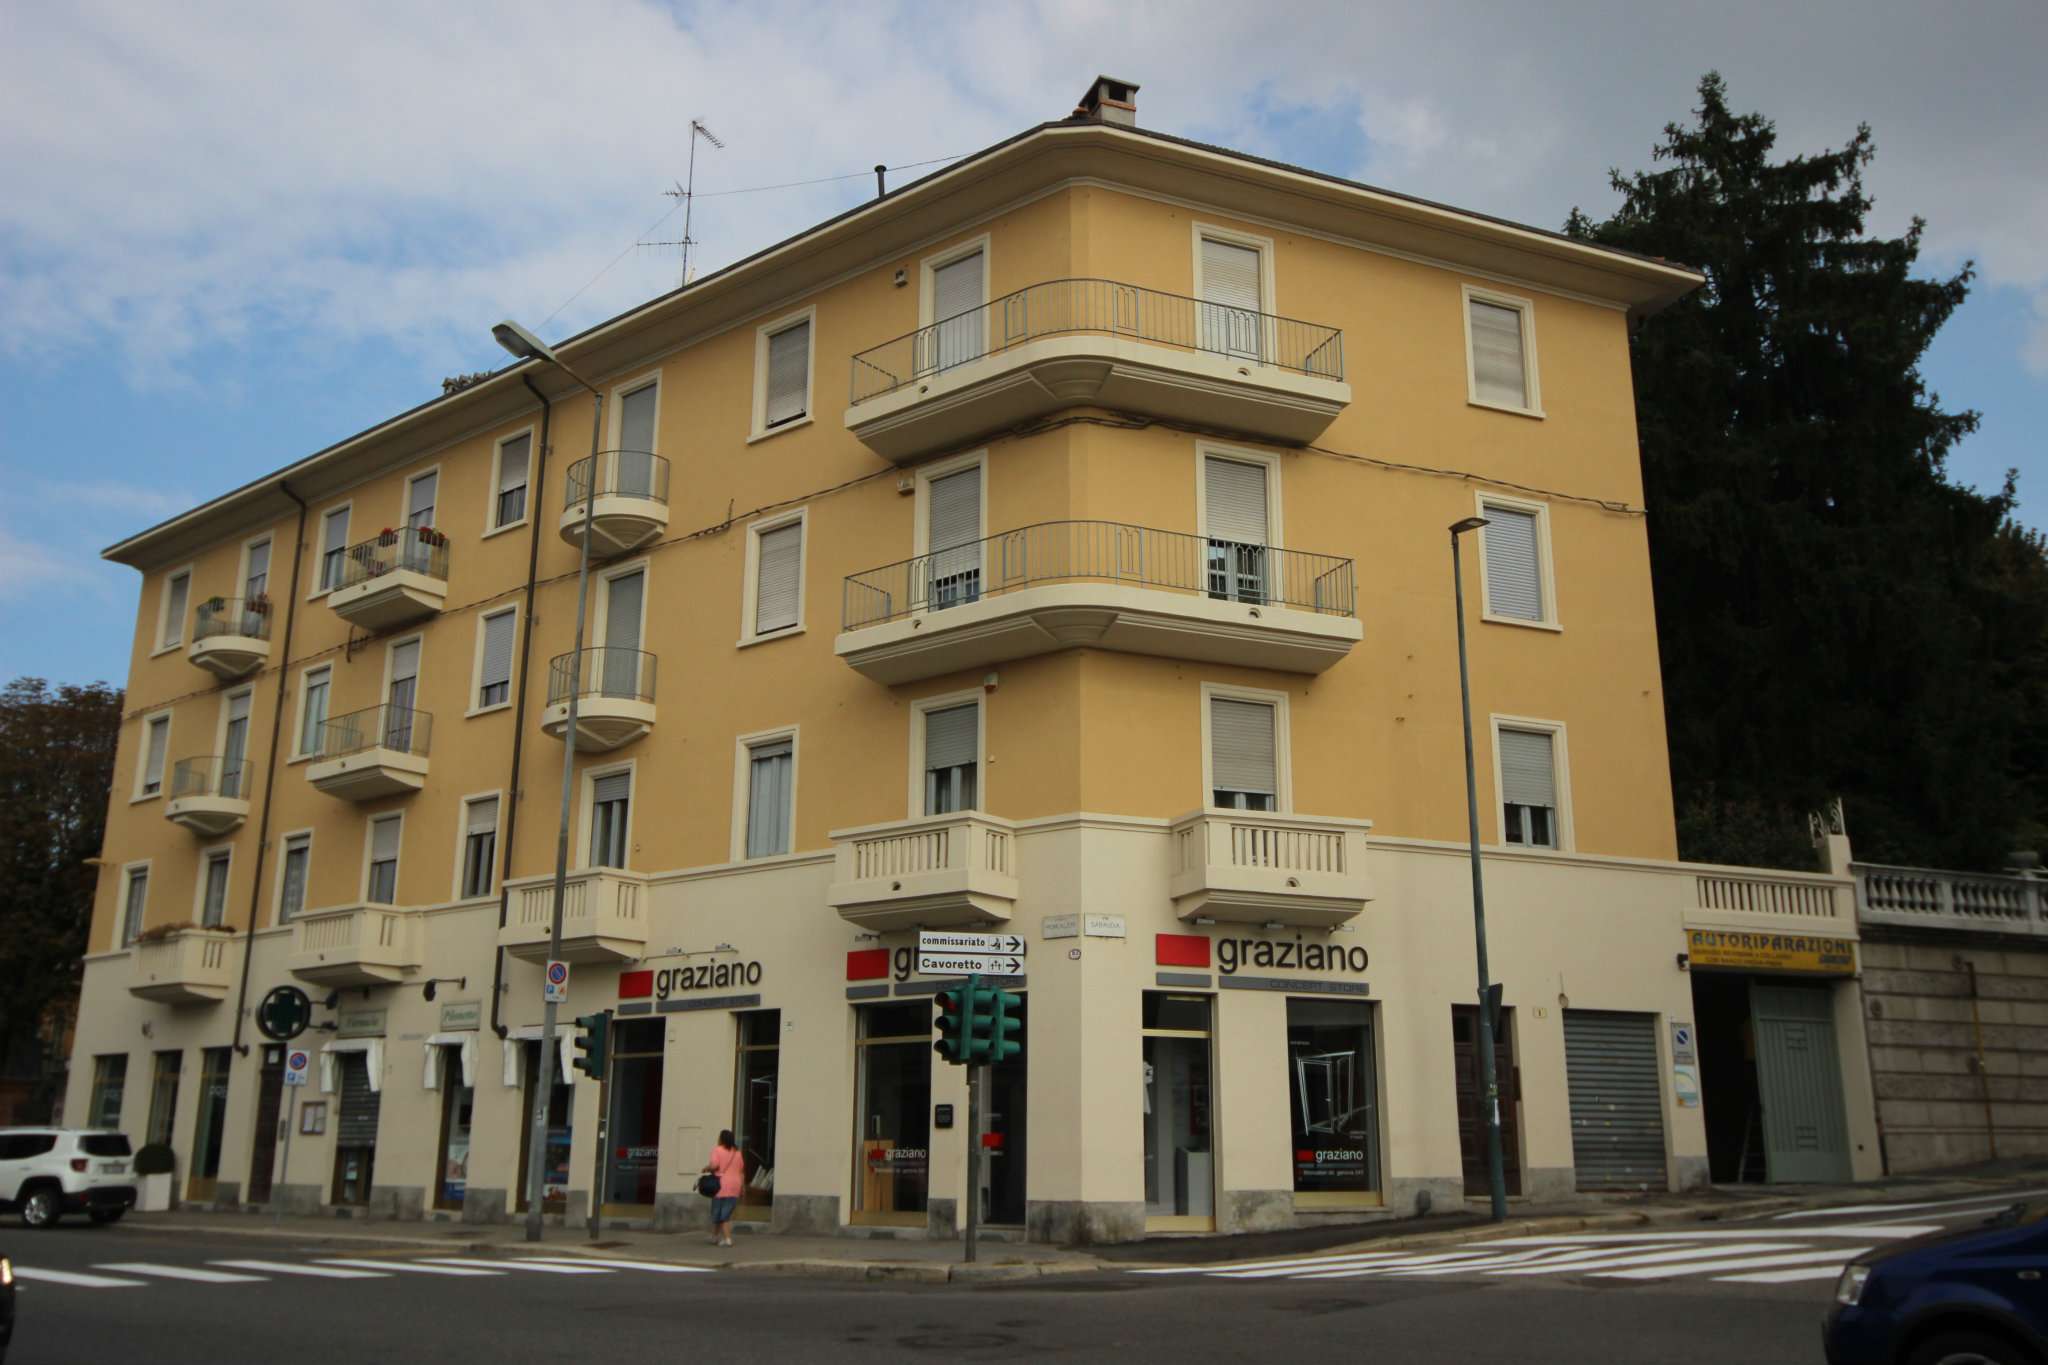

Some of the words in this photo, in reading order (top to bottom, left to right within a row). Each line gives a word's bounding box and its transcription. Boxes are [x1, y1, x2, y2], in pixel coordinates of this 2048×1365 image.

[921, 936, 986, 947] commissariato
[1217, 934, 1369, 974] graziano
[921, 958, 982, 969] Cavoretto
[656, 958, 762, 1000] graziano
[885, 1146, 926, 1160] graziano
[1315, 1148, 1364, 1163] graziano
